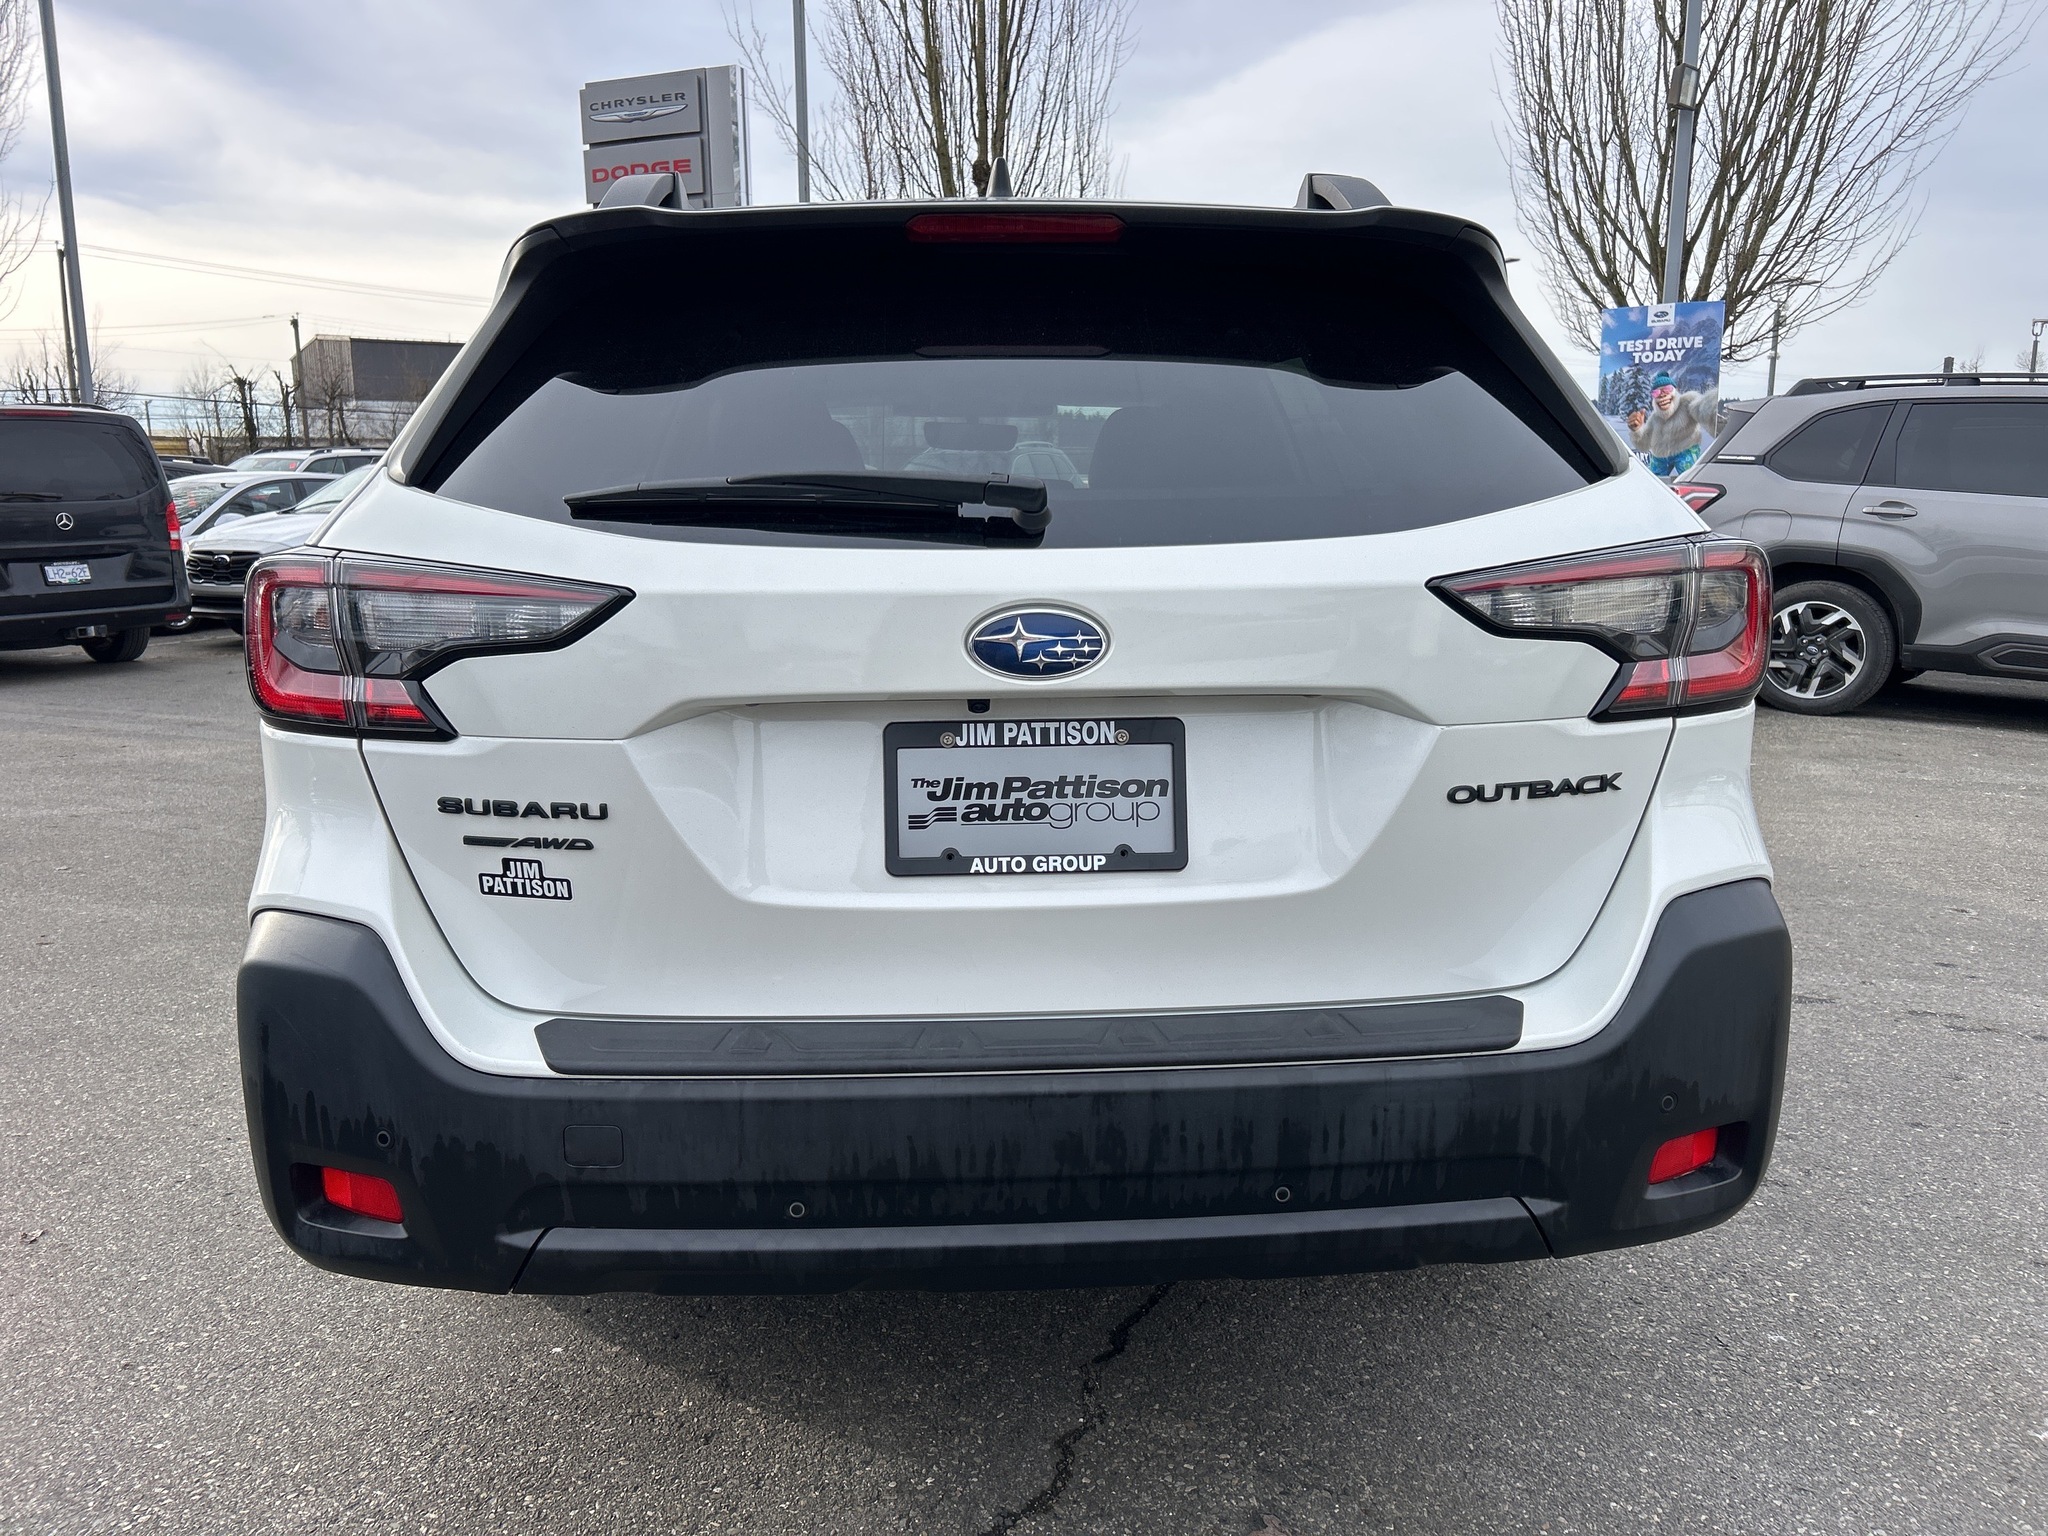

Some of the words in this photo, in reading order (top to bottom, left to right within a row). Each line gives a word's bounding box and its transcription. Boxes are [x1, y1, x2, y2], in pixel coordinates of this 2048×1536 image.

[590, 92, 686, 111] CHRYSLER
[592, 159, 692, 183] DODGE
[1618, 339, 1653, 353] TEST
[1656, 336, 1703, 350] DRIVE
[1633, 349, 1686, 364] TODAY
[955, 722, 996, 747] JIM
[1003, 720, 1115, 746] PATTISON
[911, 777, 941, 789] The
[926, 777, 999, 801] Jim
[1000, 774, 1170, 800] Pattison
[1446, 771, 1624, 804] OUTBACK
[437, 796, 608, 820] SUBARU
[511, 836, 595, 851] AWD
[506, 861, 540, 879] JIM
[970, 856, 1027, 874] AUTO
[1032, 854, 1107, 873] GROUP
[481, 876, 569, 898] PATTISON
